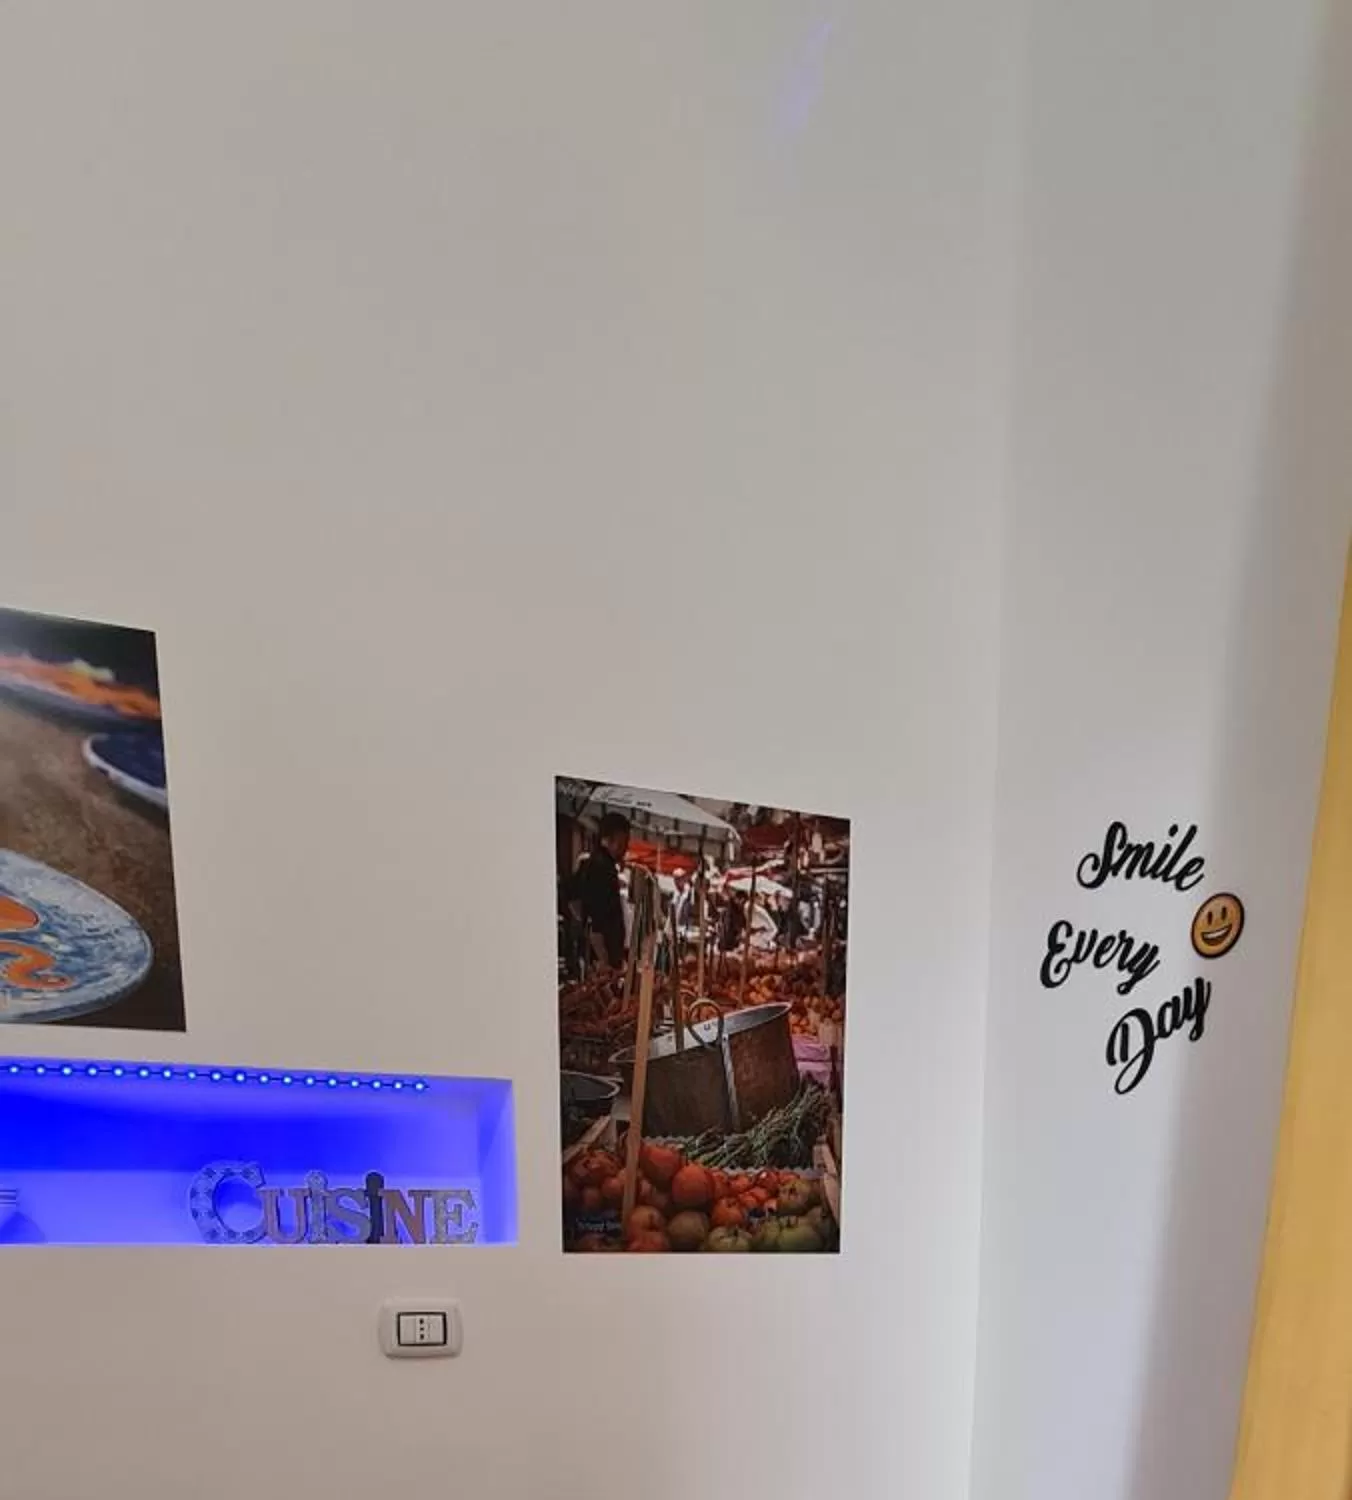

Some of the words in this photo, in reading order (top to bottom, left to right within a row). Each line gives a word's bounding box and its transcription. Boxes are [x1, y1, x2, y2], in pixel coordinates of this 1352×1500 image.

[1077, 821, 1205, 891] Smile
[1040, 920, 1160, 995] Every
[1106, 977, 1211, 1095] Day
